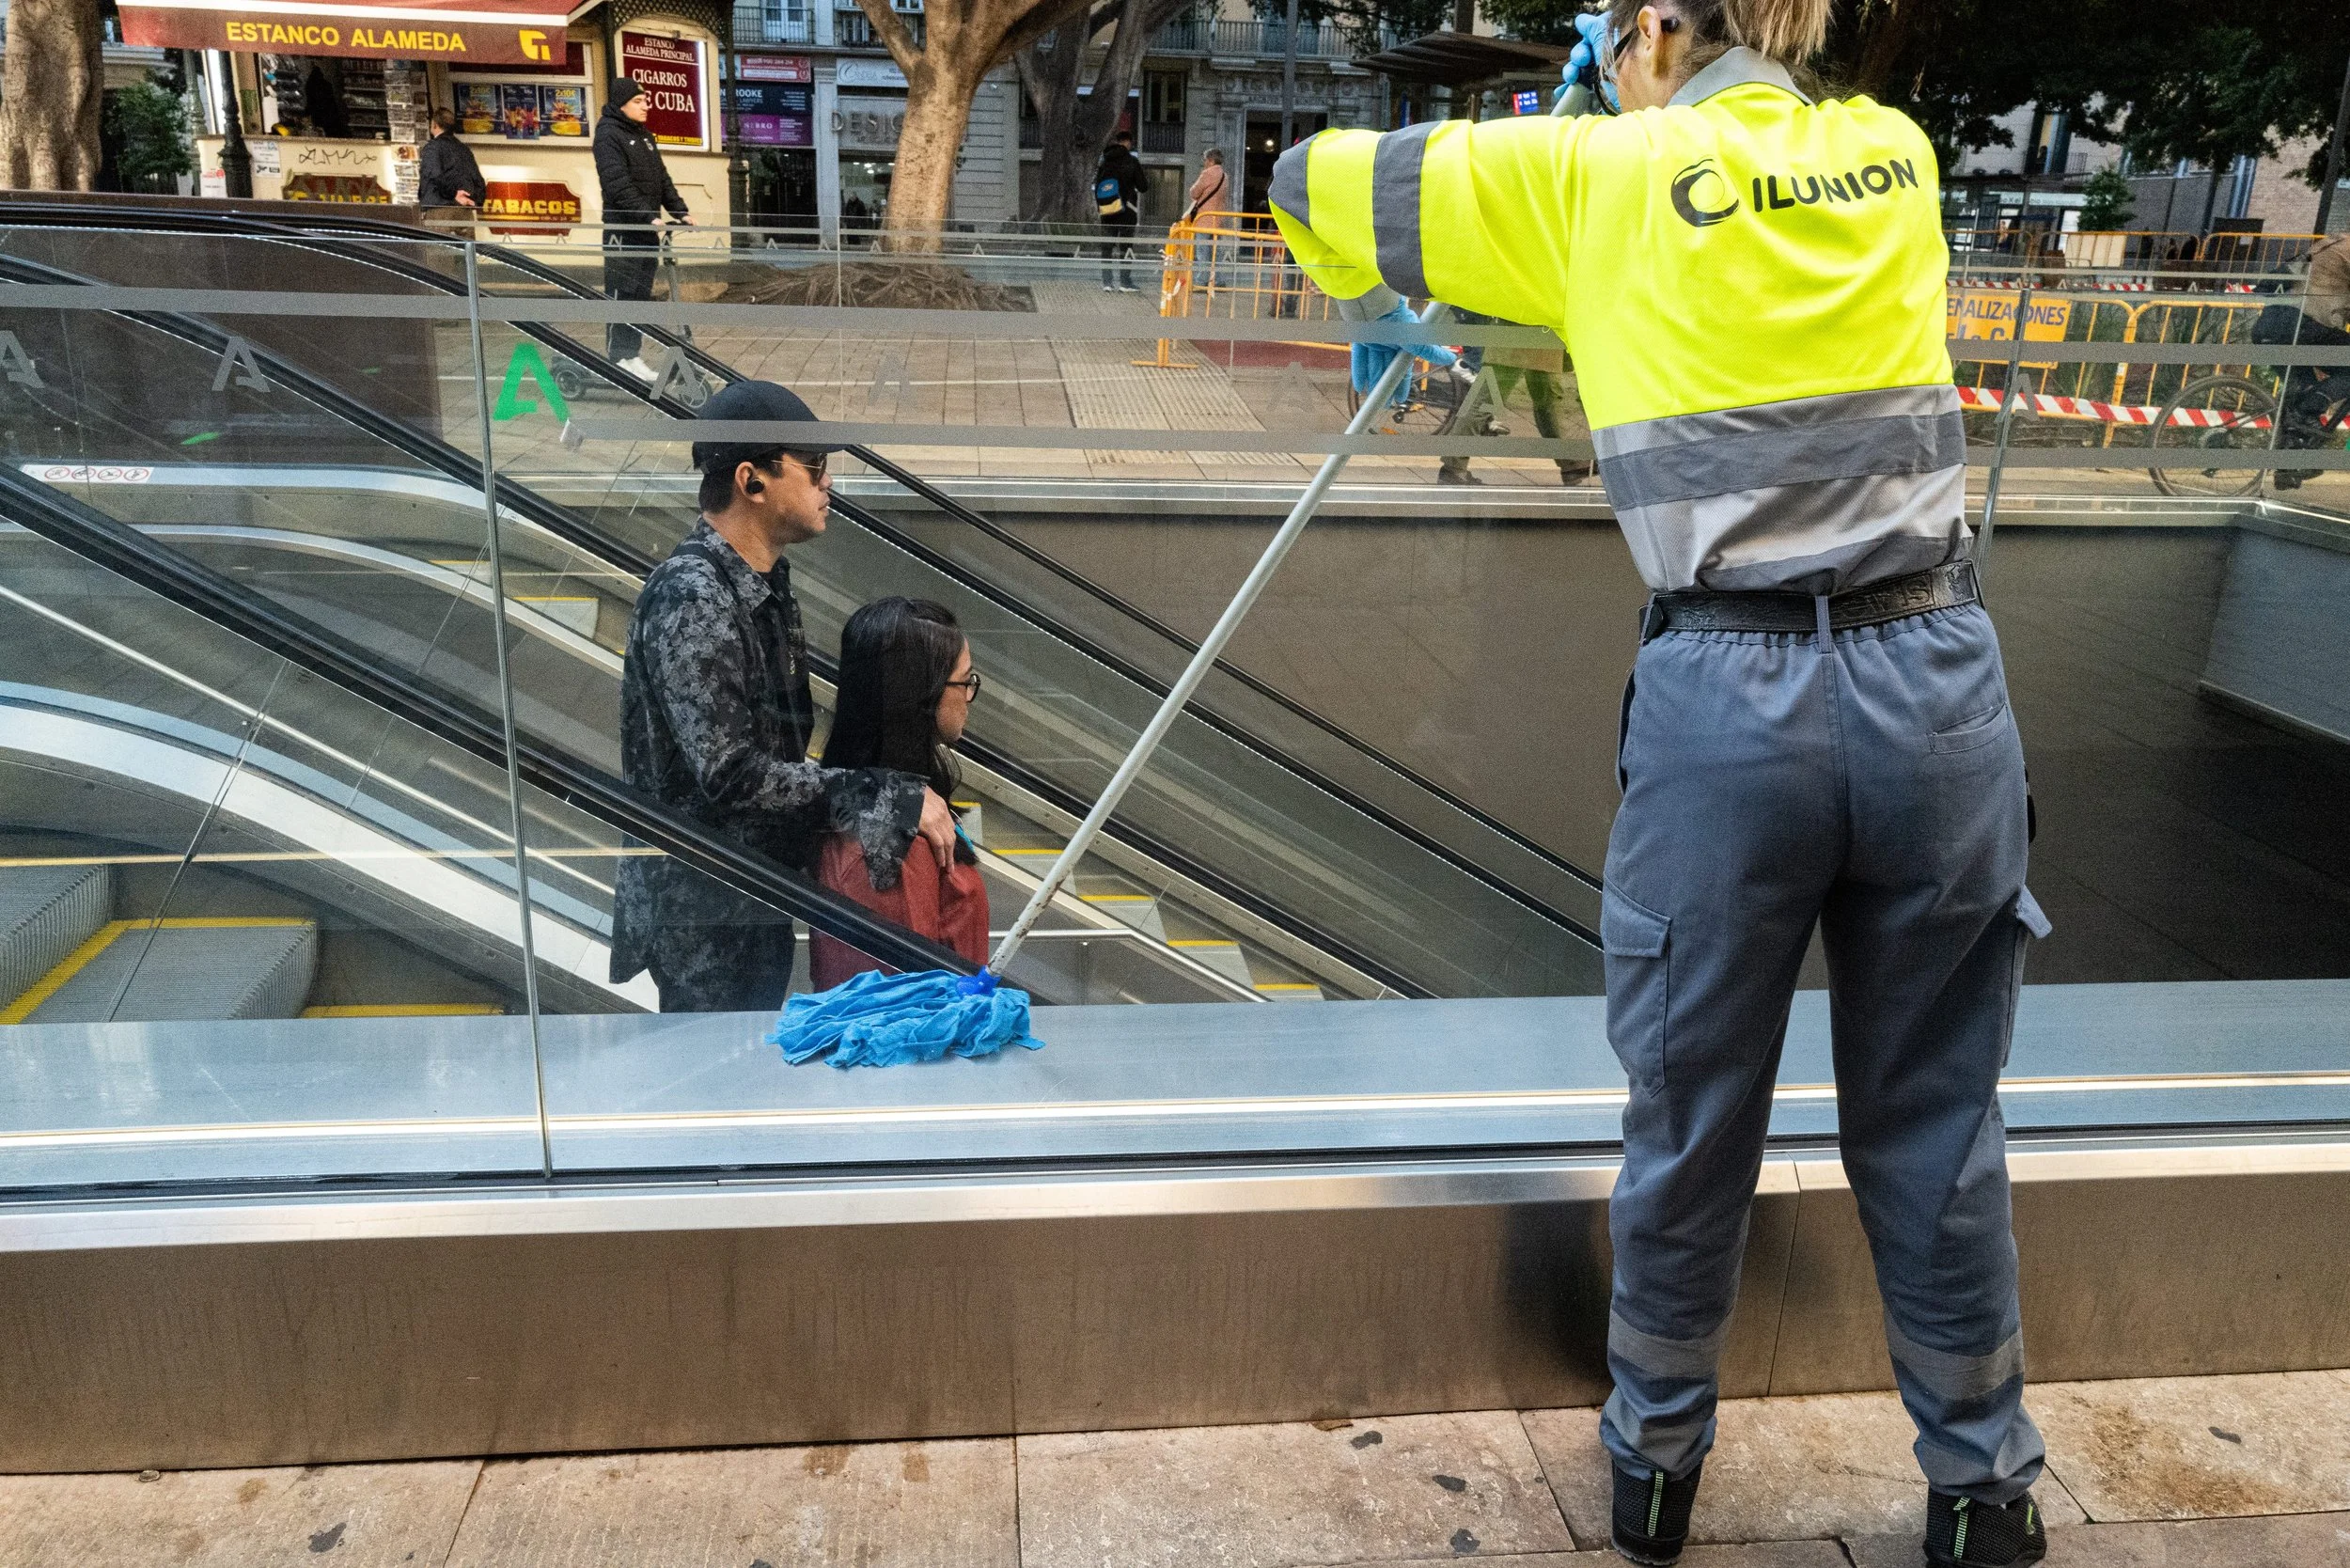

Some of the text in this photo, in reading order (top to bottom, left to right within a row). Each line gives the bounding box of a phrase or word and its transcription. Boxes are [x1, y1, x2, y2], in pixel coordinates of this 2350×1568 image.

[226, 22, 466, 52] ESTANCO ALAMEDA
[644, 37, 675, 50] ESTANCO
[626, 44, 695, 62] ALAMEDA PRINCIPAL
[632, 69, 687, 87] CIGARROS
[655, 91, 696, 113] CUBA
[1752, 158, 1919, 212] ILUNION
[482, 198, 576, 215] TABACOS
